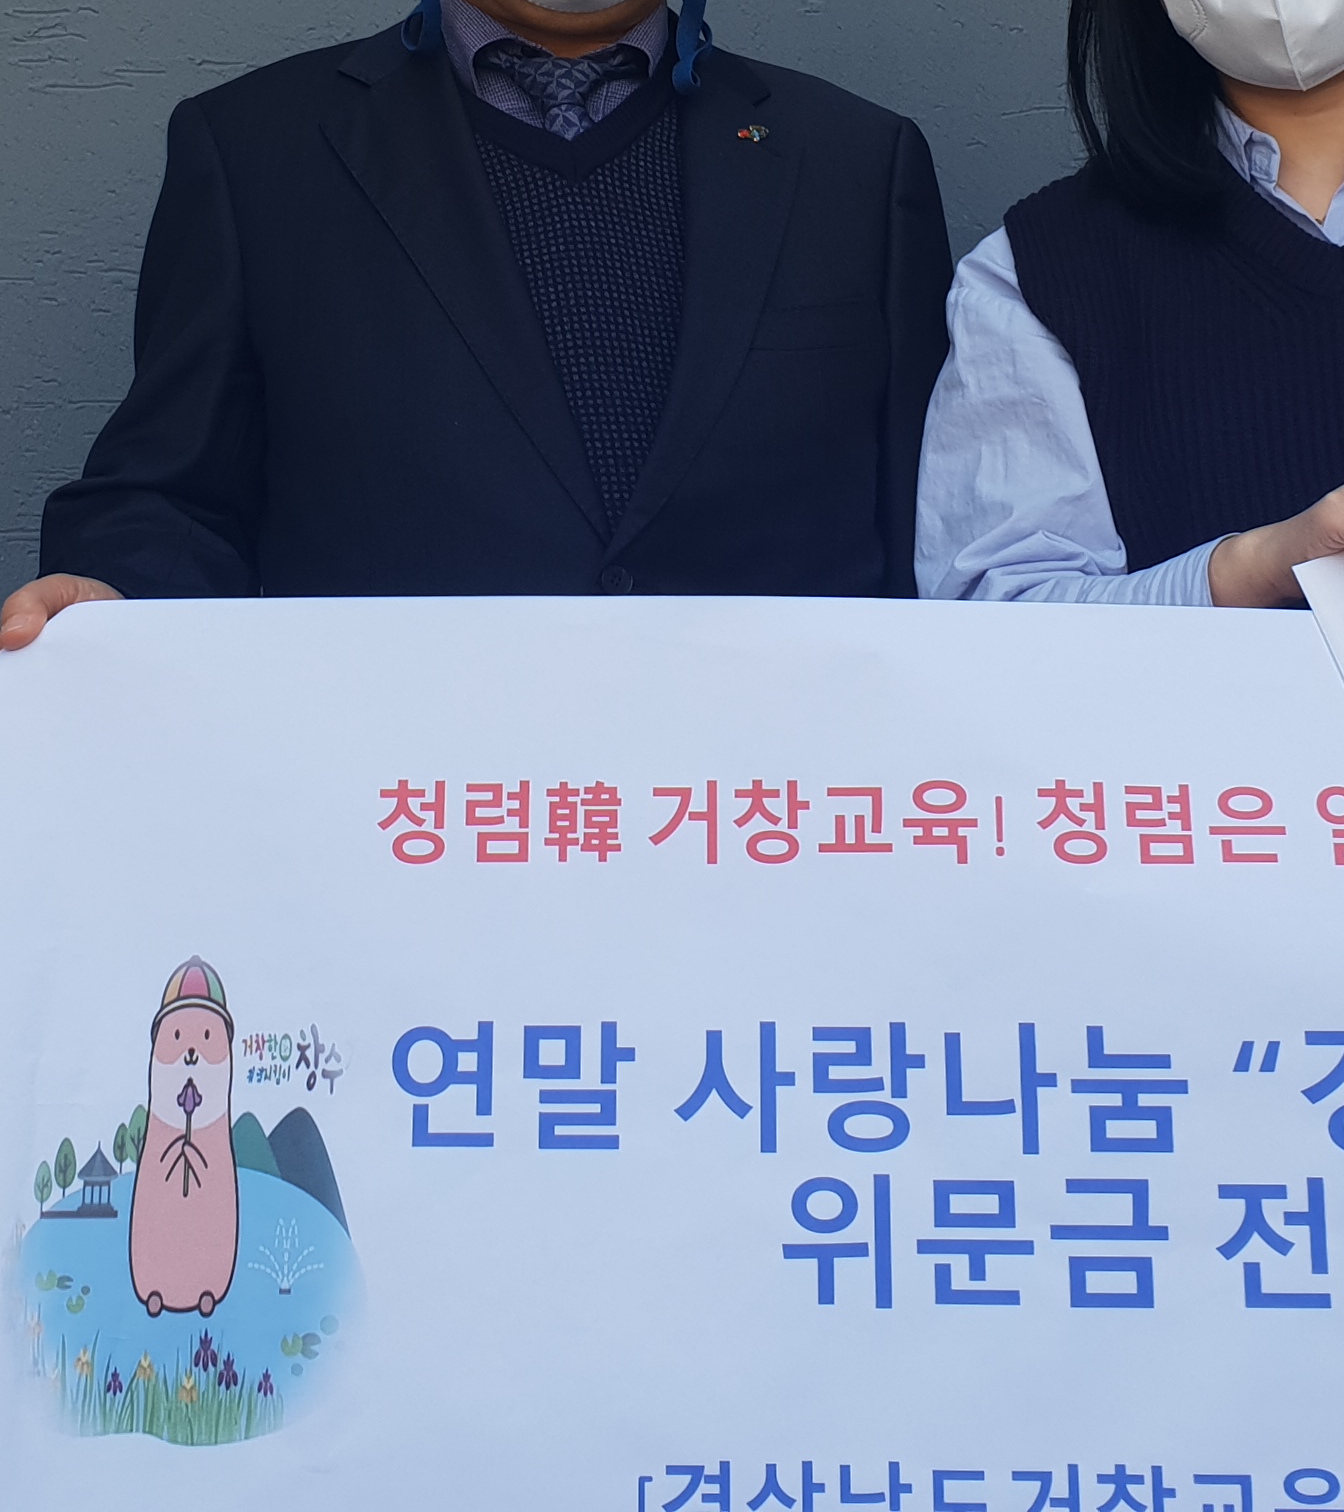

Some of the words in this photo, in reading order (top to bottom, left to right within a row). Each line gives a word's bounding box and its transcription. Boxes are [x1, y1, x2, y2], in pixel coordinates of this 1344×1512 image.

[379, 780, 622, 865] 청렴韓
[650, 780, 1005, 865] 거창교육!
[1038, 780, 1286, 865] 청렴은
[295, 1023, 344, 1095] 창수
[391, 1021, 636, 1151] 연말
[675, 1021, 1189, 1156] 사랑나눔
[782, 1174, 1170, 1310] 위문금
